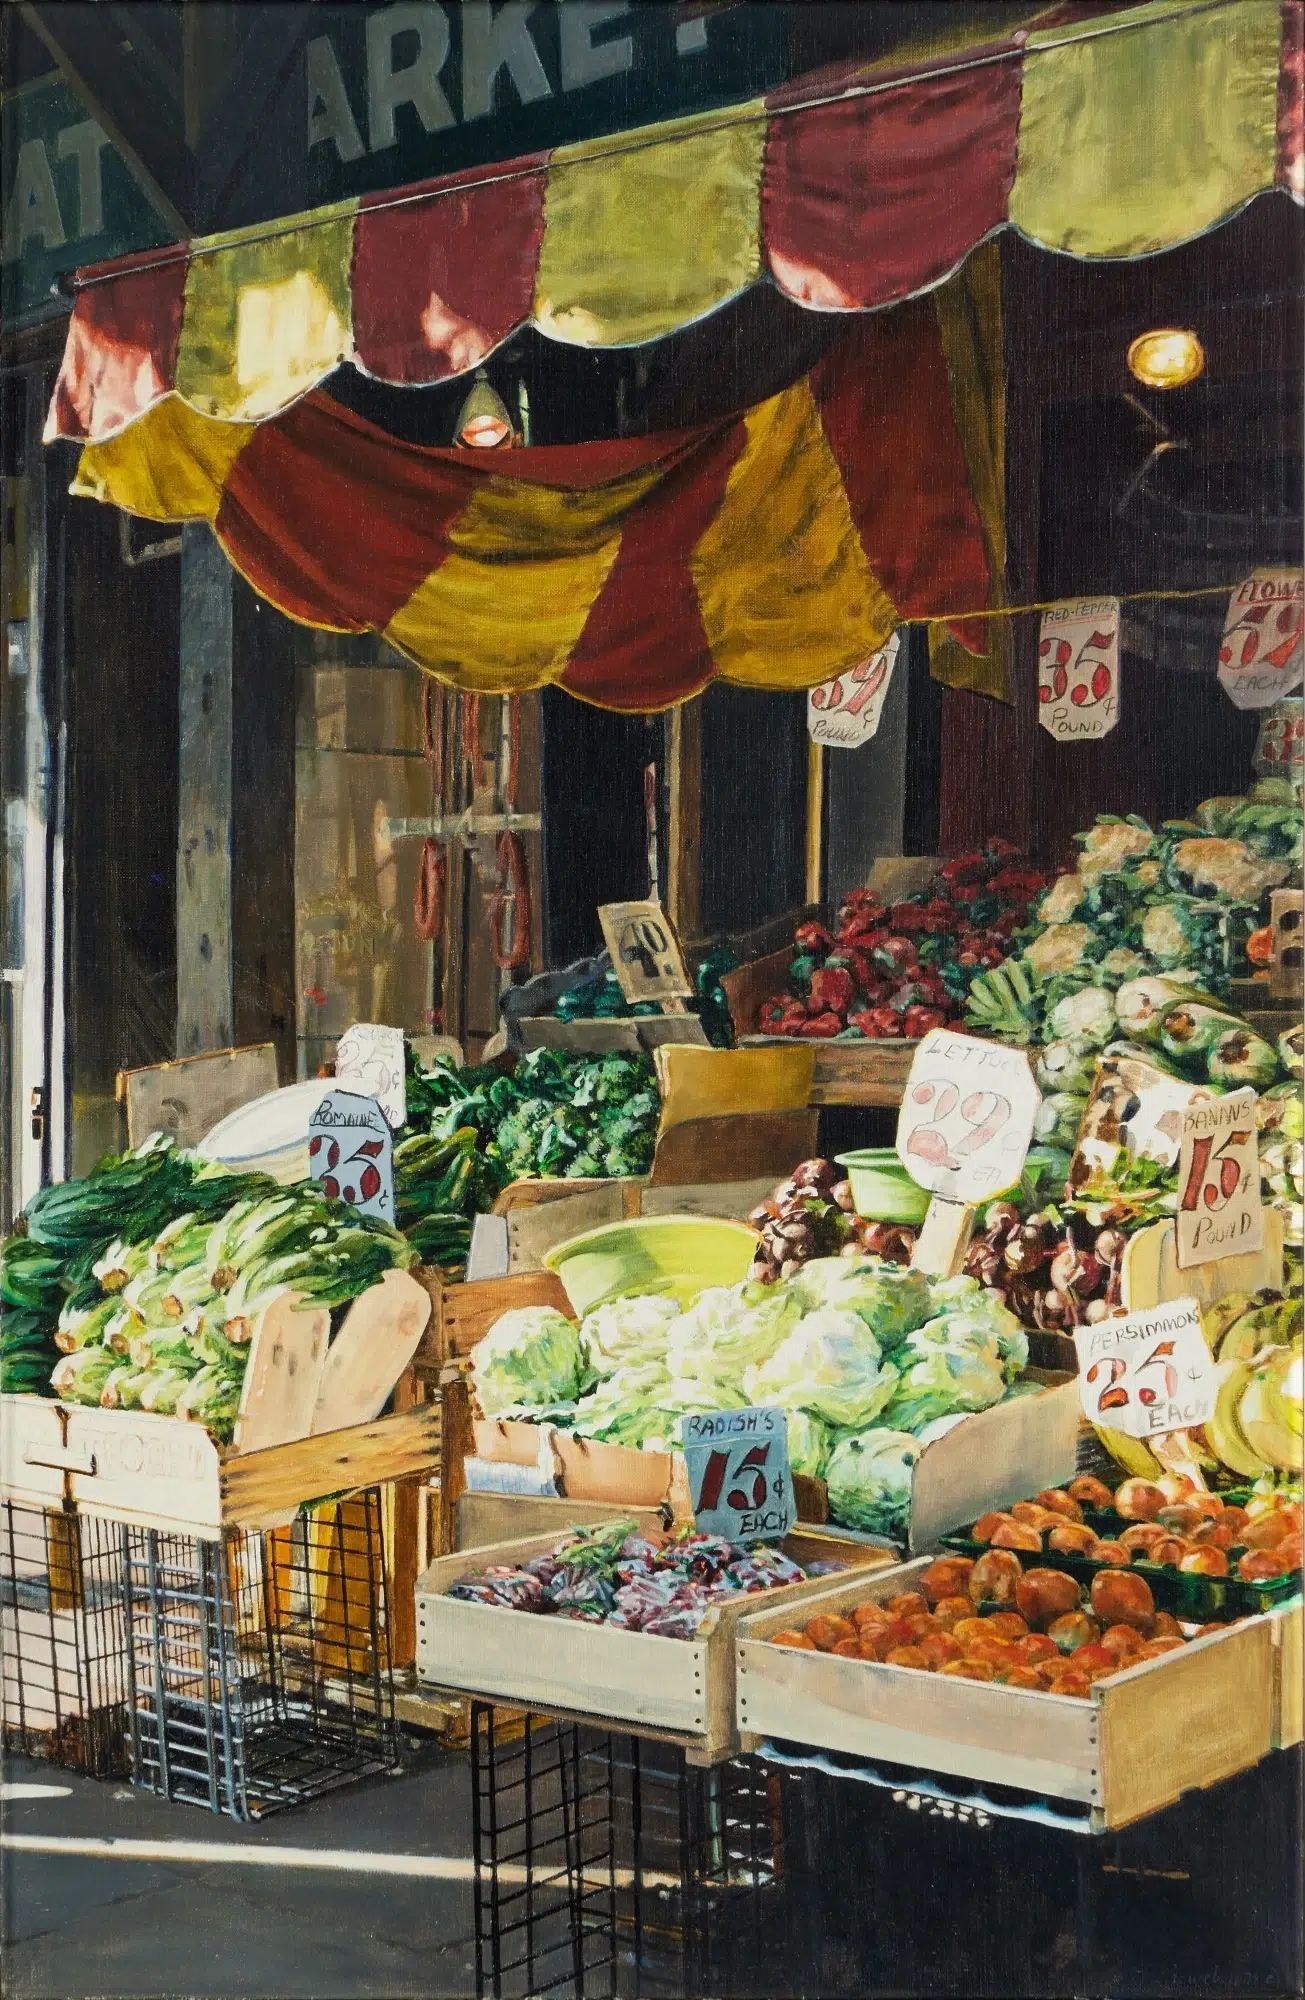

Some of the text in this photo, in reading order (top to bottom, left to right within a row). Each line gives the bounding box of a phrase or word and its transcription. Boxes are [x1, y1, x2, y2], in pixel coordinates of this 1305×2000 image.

[306, 0, 708, 164] ARKE
[1233, 675, 1288, 691] EACH
[313, 1099, 381, 1127] ROMAINE
[688, 1411, 775, 1437] RADISH'S
[1149, 1400, 1208, 1429] EACH
[739, 1510, 788, 1536] EACH
